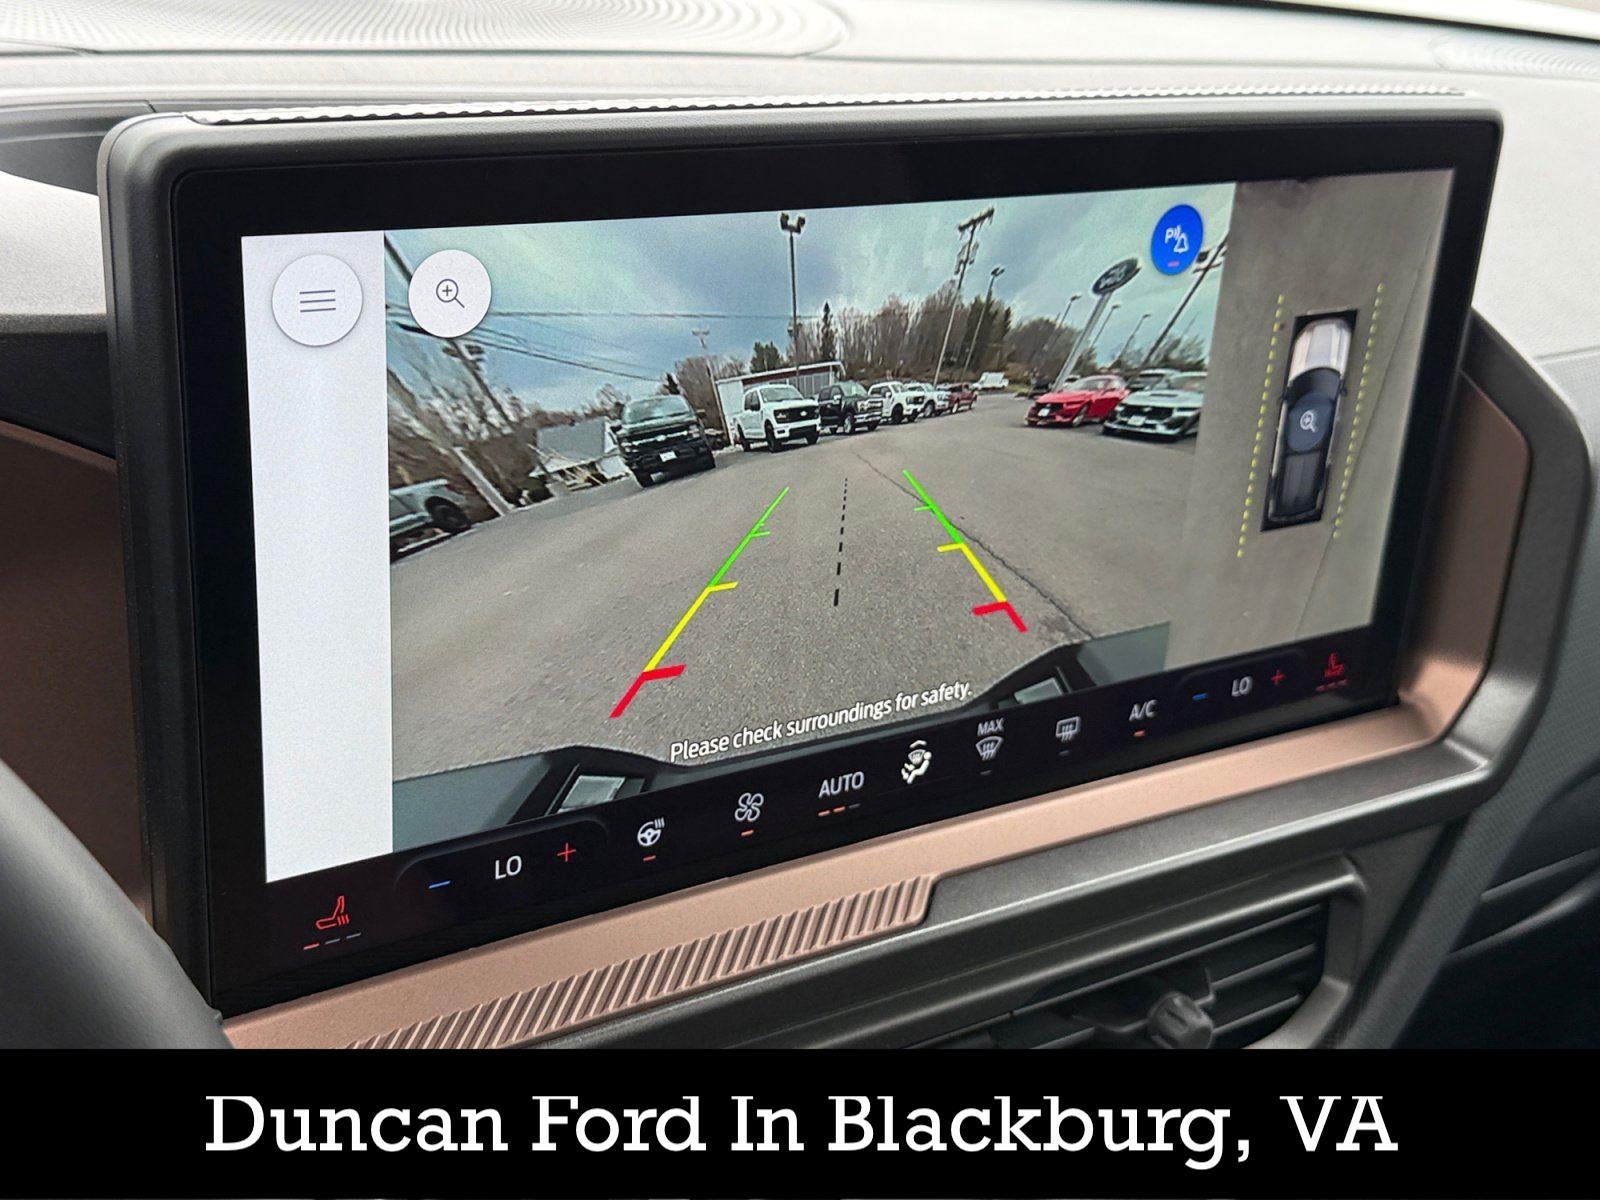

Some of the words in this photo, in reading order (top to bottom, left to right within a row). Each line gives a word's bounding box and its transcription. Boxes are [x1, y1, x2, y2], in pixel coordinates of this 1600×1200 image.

[1231, 675, 1253, 697] LO
[670, 735, 729, 763] Please
[732, 720, 783, 749] check
[786, 699, 891, 737] surroundings
[895, 692, 918, 712] for
[920, 680, 973, 706] safety.
[1128, 700, 1157, 722] A/C
[976, 718, 1004, 735] MAX
[818, 771, 865, 798] AUTO
[494, 855, 522, 880] LO
